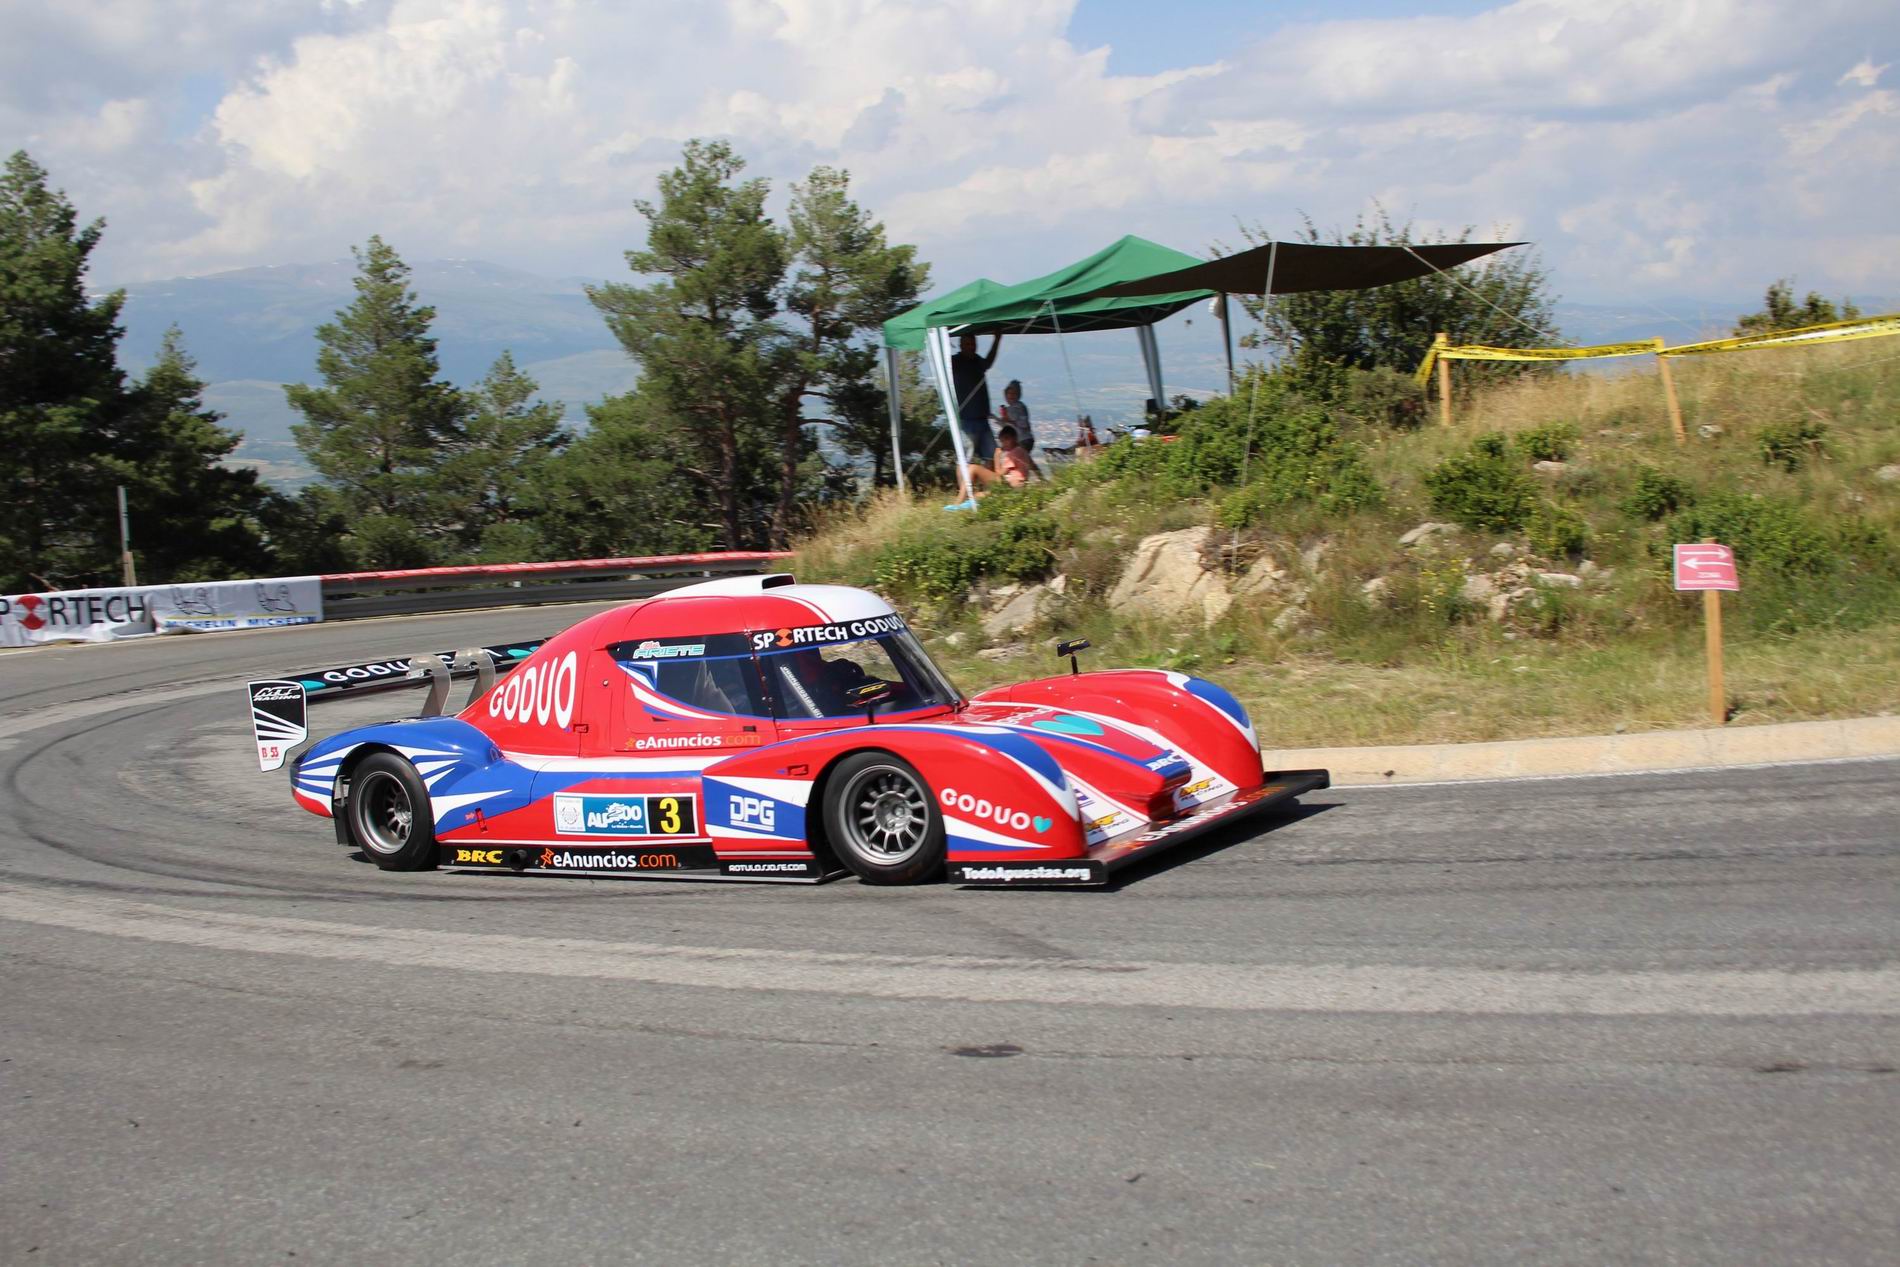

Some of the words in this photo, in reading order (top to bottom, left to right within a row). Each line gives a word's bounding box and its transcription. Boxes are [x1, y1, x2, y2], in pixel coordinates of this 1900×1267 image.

[165, 619, 237, 629] MICHELIN
[247, 615, 317, 627] MICHELIN
[851, 616, 904, 637] GODUO
[632, 644, 706, 660] ARIETE
[323, 657, 412, 683] GODU
[489, 650, 577, 729] GODUO
[635, 733, 761, 749] eAnuncios.com
[1145, 754, 1187, 771] BRC
[659, 797, 681, 834] 3
[730, 795, 775, 826] DPG
[940, 787, 1031, 830] GODUO
[456, 849, 503, 864] BRC
[552, 850, 677, 868] eAnuncios.com
[961, 866, 1091, 881] TodoApuestas.org
